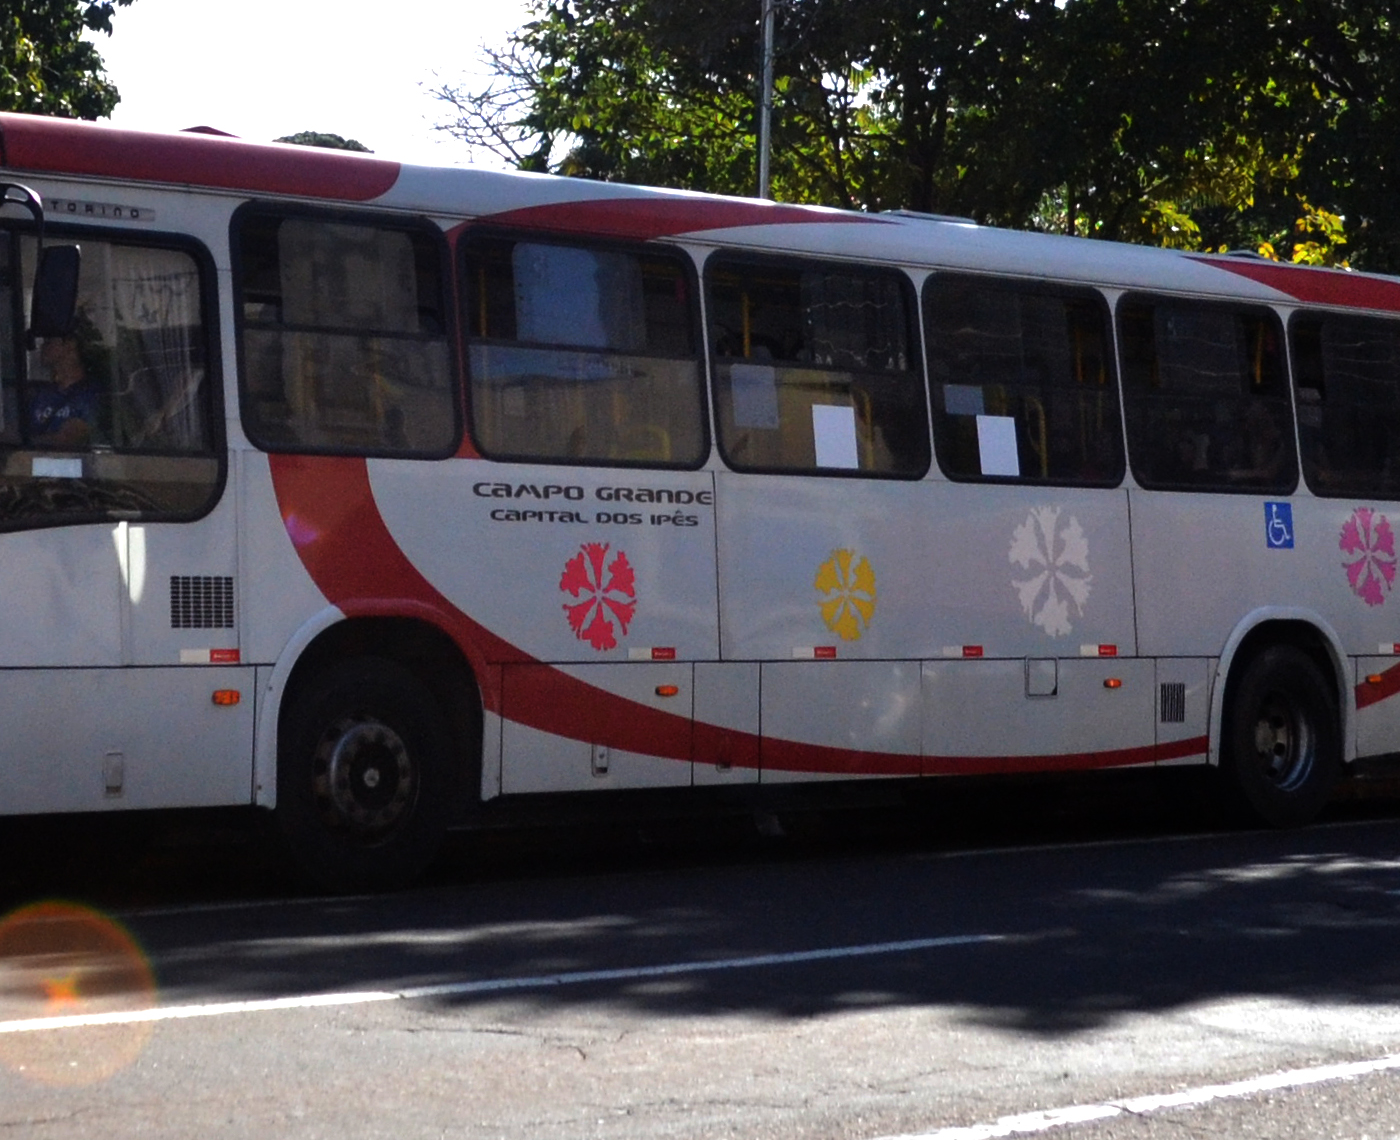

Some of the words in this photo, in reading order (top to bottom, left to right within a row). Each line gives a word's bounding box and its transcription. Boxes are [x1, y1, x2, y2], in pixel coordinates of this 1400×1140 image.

[51, 201, 140, 219] TORINO
[473, 482, 585, 500] CAMPO
[595, 486, 714, 506] GRANDE
[490, 509, 589, 523] CAPITAL
[596, 511, 643, 524] DOS
[650, 510, 699, 527] IPÊS
